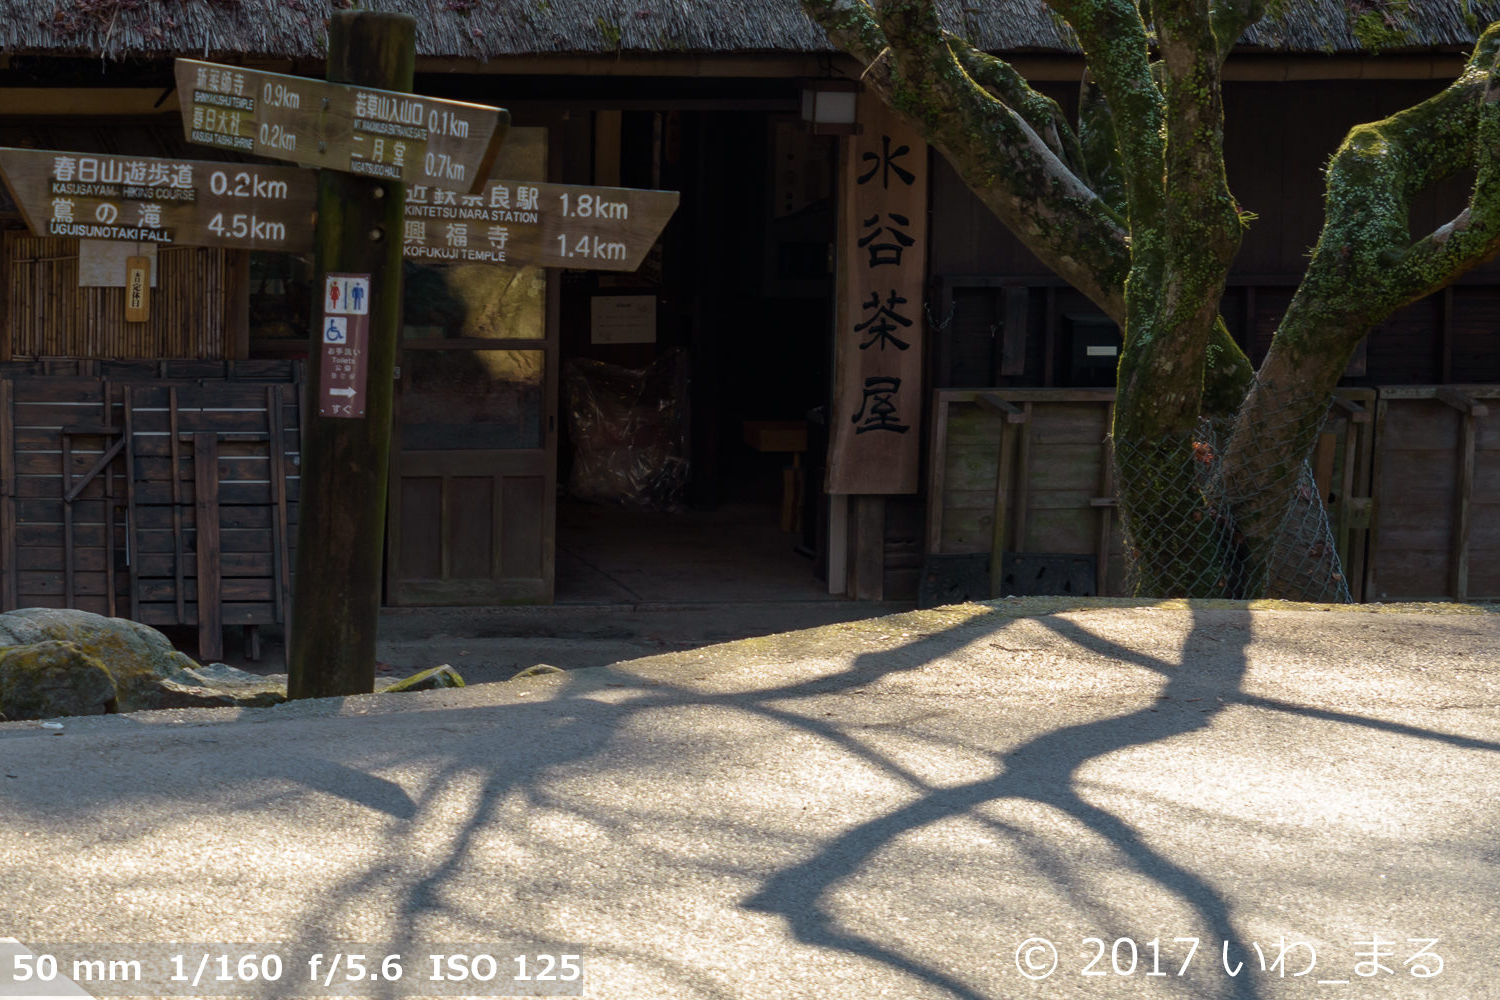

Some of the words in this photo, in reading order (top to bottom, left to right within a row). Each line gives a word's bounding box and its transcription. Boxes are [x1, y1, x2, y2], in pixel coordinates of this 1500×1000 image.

[263, 82, 300, 109] 0.9km
[192, 106, 241, 136] 春日大社
[260, 123, 296, 152] 0.2km
[355, 91, 424, 125] 若草山入山口
[428, 109, 469, 138] 0.1km
[350, 136, 406, 166] 二月堂
[424, 152, 465, 181] 0.7km
[52, 155, 194, 189] 春日山遊歩道
[209, 170, 288, 199] 0.2km
[52, 182, 120, 197] KASUGAYAM
[122, 187, 154, 199] HIKING
[155, 187, 195, 201] COURSE
[404, 205, 457, 218] KINTETSU
[458, 208, 489, 220] NARA
[491, 210, 538, 224] STATION
[559, 192, 628, 220] 1.8km
[50, 223, 138, 239] UGUISUNOTAKI
[140, 229, 172, 242] FALL
[208, 212, 286, 241] 4.5km
[403, 220, 509, 249] 興福寺
[557, 233, 627, 261] 1.4km
[403, 245, 459, 259] KOFUKUJI
[461, 249, 506, 262] TEMPLE
[851, 135, 915, 435] 水谷茶屋
